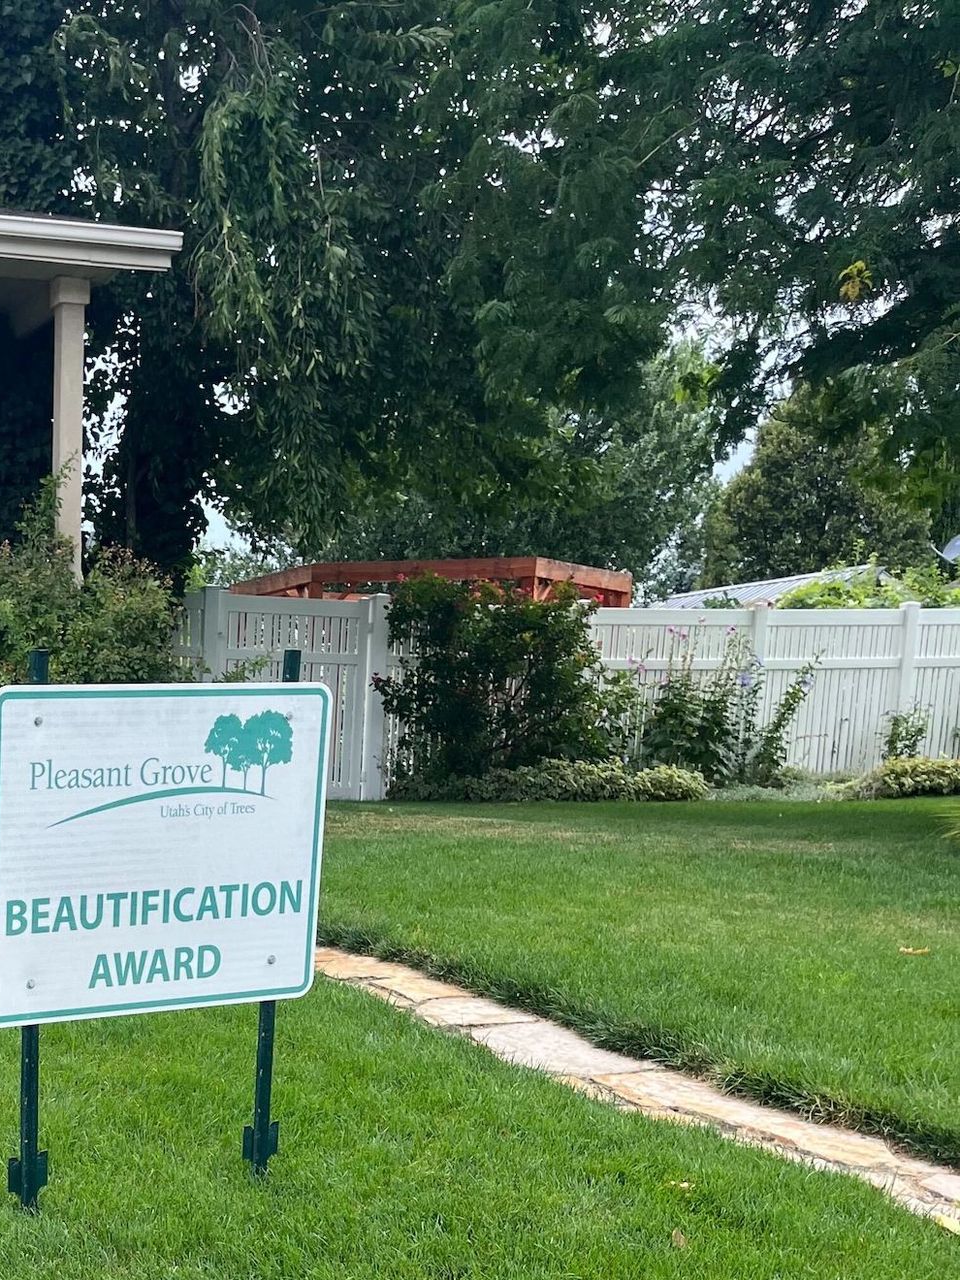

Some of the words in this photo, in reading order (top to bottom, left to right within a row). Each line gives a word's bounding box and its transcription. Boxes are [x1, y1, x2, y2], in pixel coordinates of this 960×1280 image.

[29, 758, 132, 791] Pleasant
[140, 756, 213, 786] Grove
[160, 803, 191, 818] Utah's
[193, 803, 215, 820] City
[217, 801, 228, 815] of
[229, 802, 255, 815] Trees
[5, 879, 303, 936] BEAUTIFICATION
[88, 944, 222, 989] AWARD
